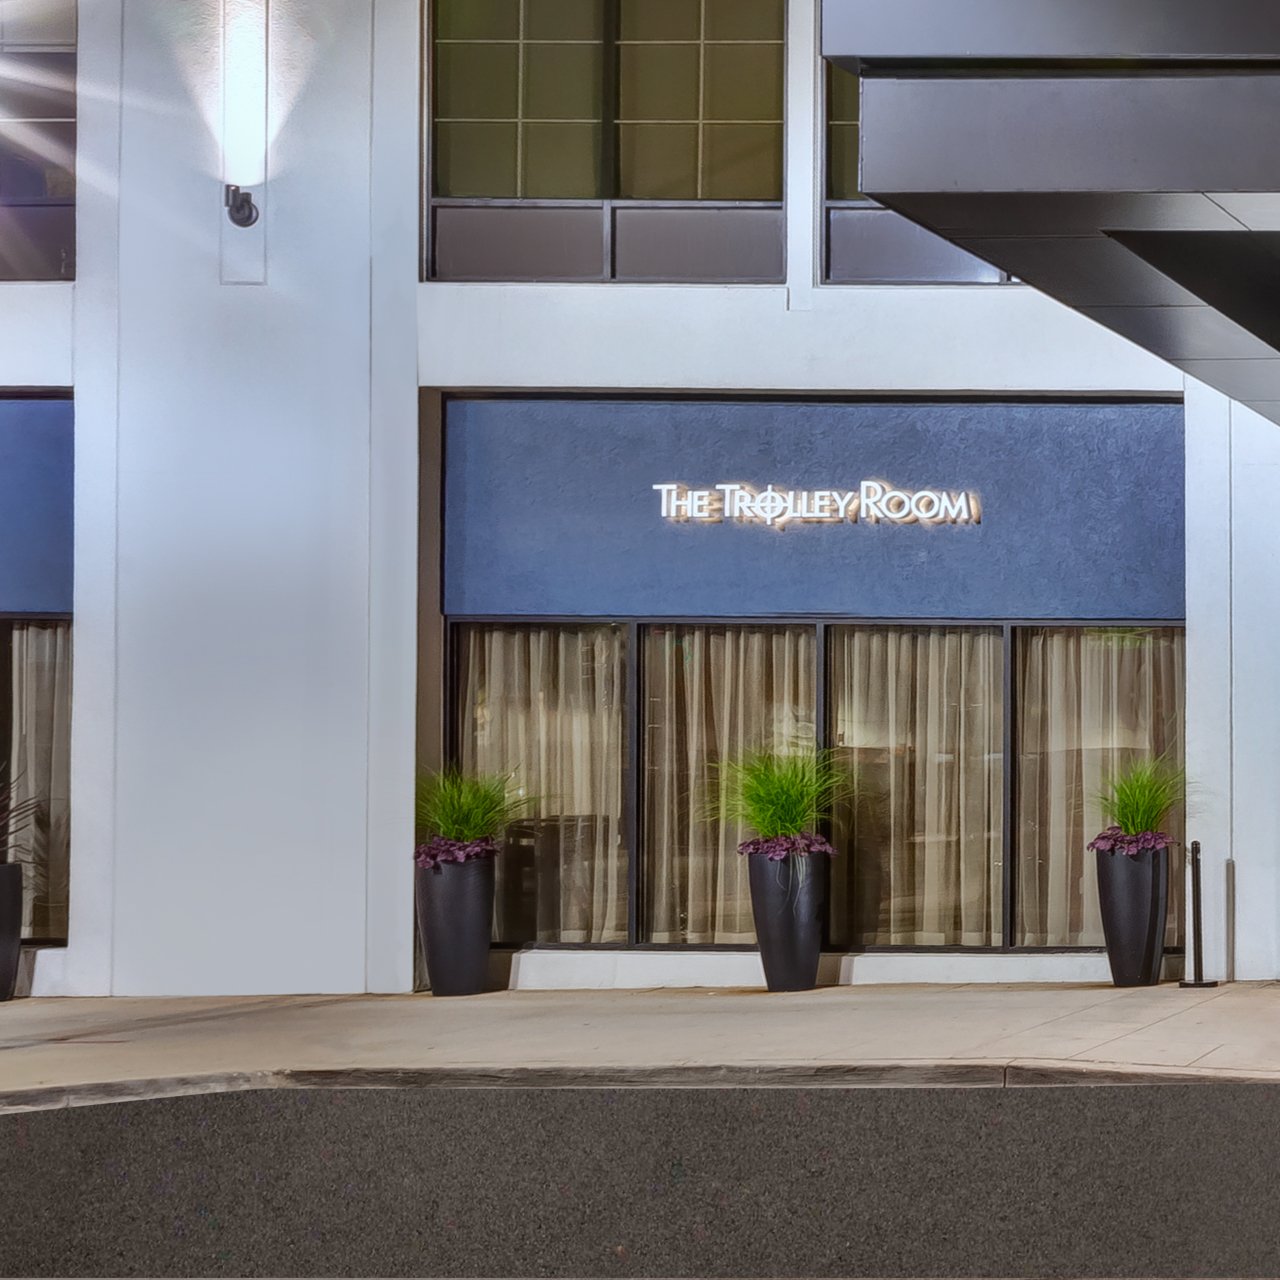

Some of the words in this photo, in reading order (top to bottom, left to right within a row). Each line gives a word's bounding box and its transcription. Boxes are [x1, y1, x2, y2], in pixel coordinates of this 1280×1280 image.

[652, 483, 710, 518] THE
[715, 483, 855, 525] TROLLEY
[860, 480, 970, 520] ROOM
